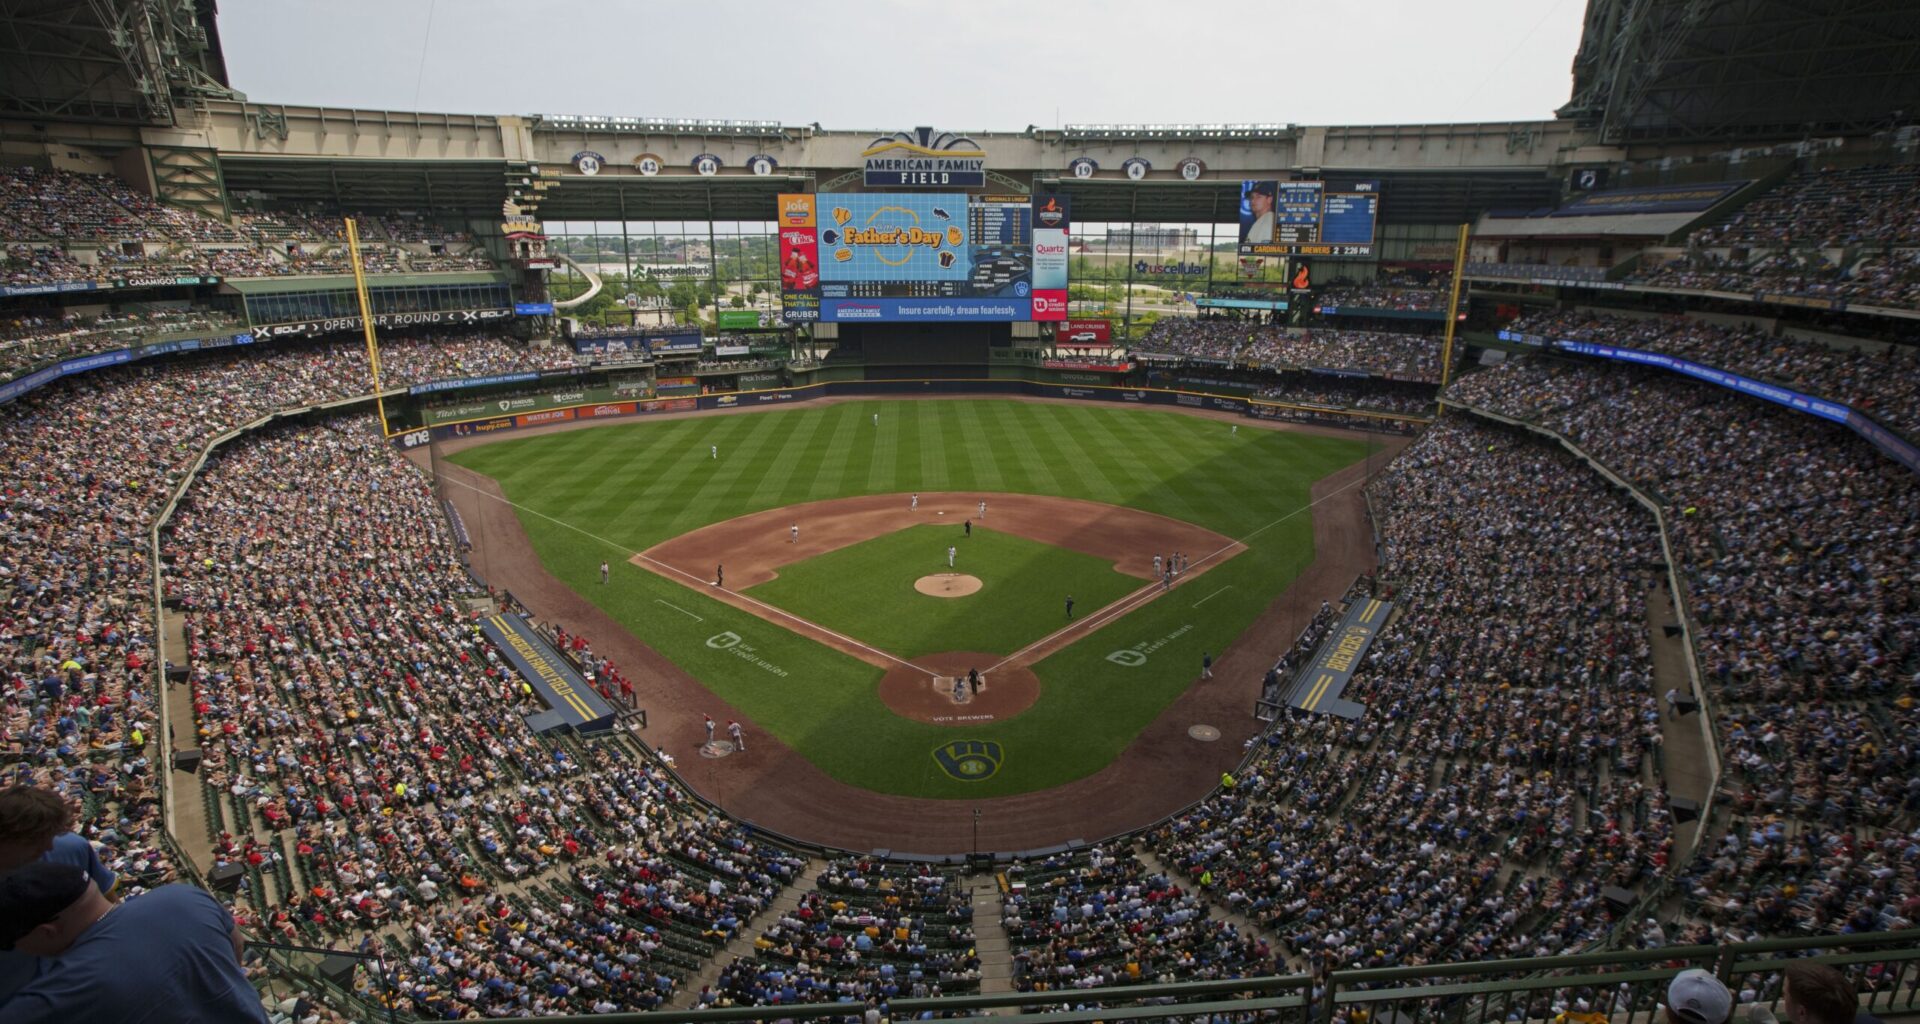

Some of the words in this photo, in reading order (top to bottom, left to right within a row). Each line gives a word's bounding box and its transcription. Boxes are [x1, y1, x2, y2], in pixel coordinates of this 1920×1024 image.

[582, 160, 597, 171] 34
[642, 161, 656, 172] 42
[700, 162, 714, 173] 44
[865, 159, 932, 170] AMERICAN
[938, 159, 984, 171] FAMILY
[1078, 166, 1090, 175] 19
[901, 173, 949, 184] FIELD
[844, 227, 909, 245] Father's
[909, 227, 943, 249] Day
[1036, 244, 1065, 254] Quartz
[1301, 246, 1330, 254] BREWERS
[1344, 247, 1359, 255] 2:26
[1359, 247, 1370, 255] PM
[646, 266, 709, 277] AssociatedBank
[1149, 262, 1208, 275] uscellular
[129, 278, 177, 287] CASAMIGOS
[785, 310, 819, 318] GRUBER
[899, 305, 921, 315] Insure
[922, 305, 956, 316] carefully,
[956, 305, 979, 315] dream
[980, 305, 1016, 316] fearlessly.
[274, 324, 306, 335] GOLF
[324, 319, 354, 331] OPEN
[358, 316, 387, 327] YAR
[394, 312, 441, 324] ROUND
[480, 310, 511, 318] GOLF
[433, 380, 465, 390] WRECK
[561, 392, 584, 401] clover
[436, 409, 458, 419] Tito's
[527, 413, 550, 422] WATER
[551, 411, 565, 419] JOE
[476, 421, 512, 432] hupy.com
[404, 430, 430, 447] one
[1326, 634, 1366, 672] BREWERS
[728, 646, 758, 663] credit
[757, 661, 789, 678] union
[530, 656, 556, 682] FAMILY
[548, 675, 574, 696] FIELD
